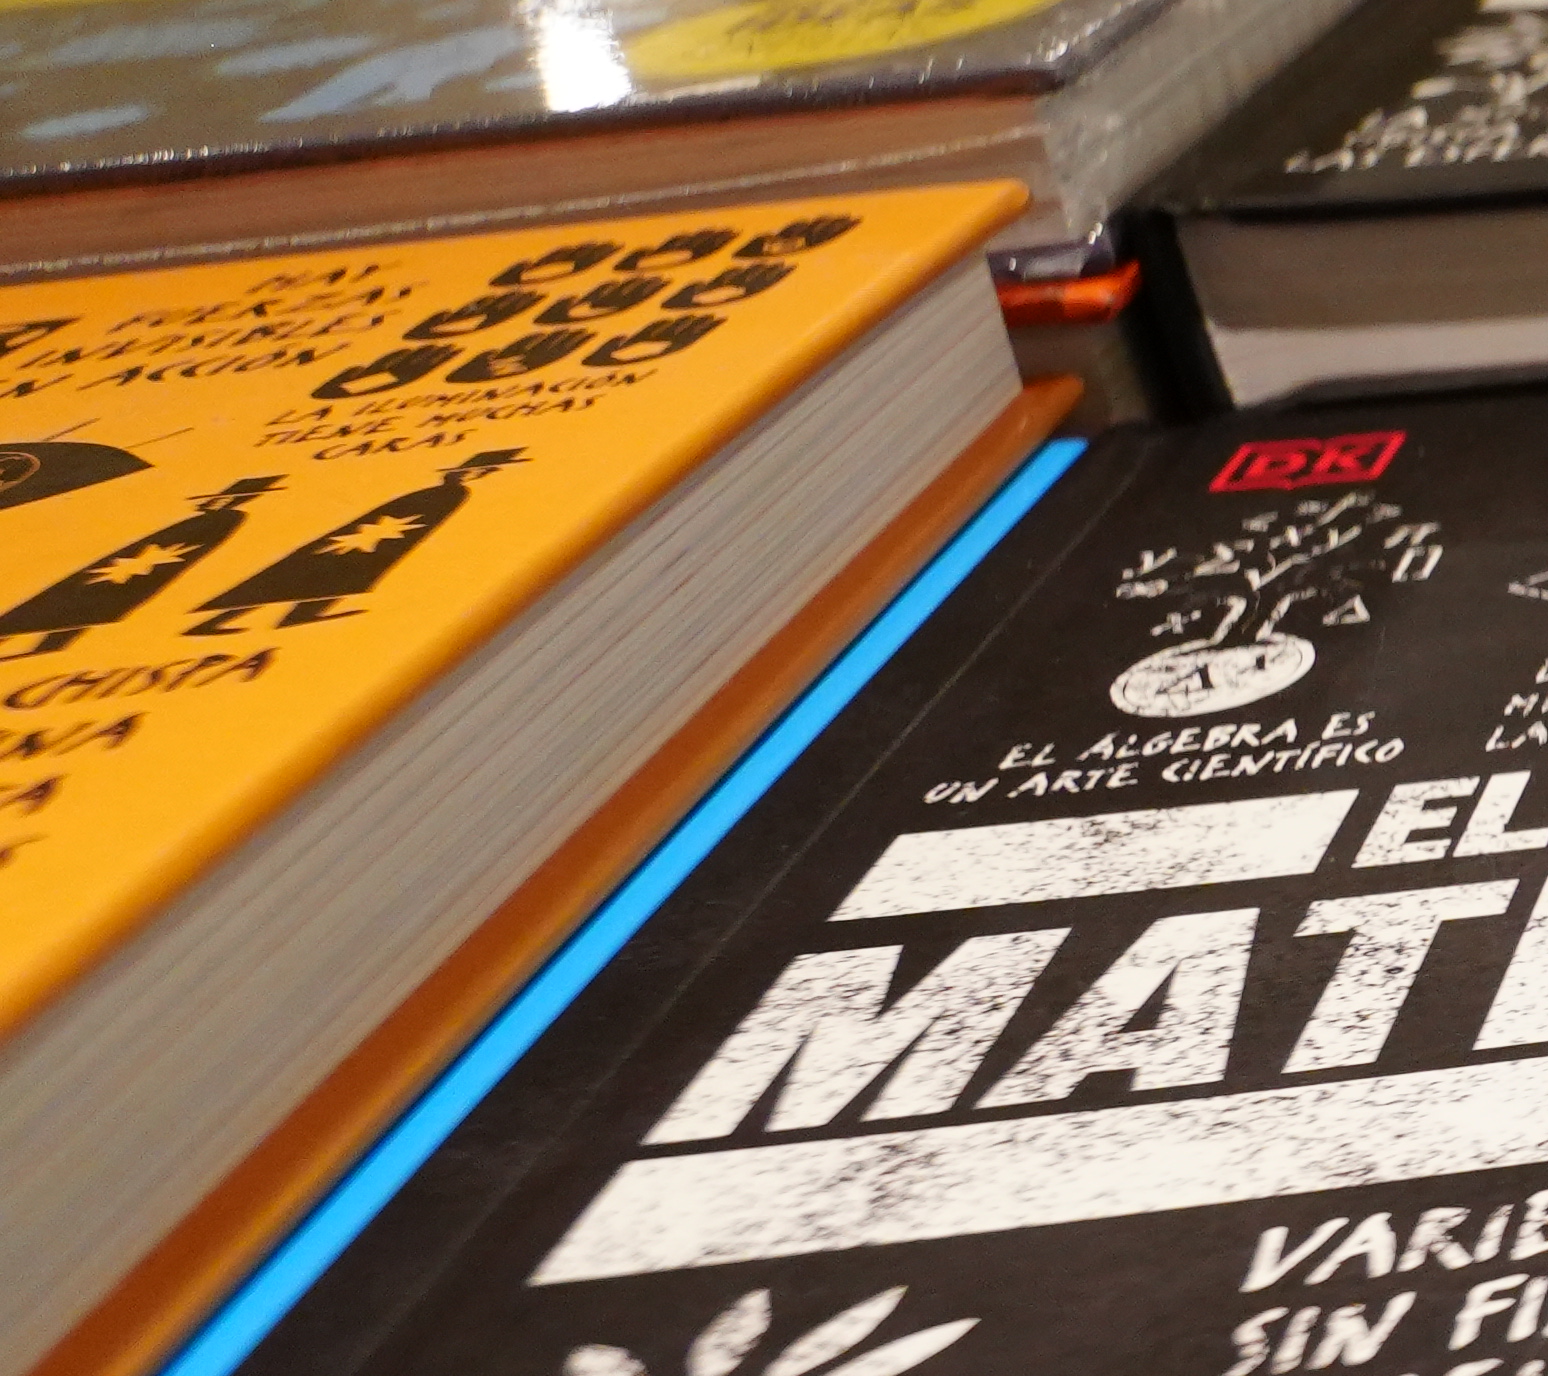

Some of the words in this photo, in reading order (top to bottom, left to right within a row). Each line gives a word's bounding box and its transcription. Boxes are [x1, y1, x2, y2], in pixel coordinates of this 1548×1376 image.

[17, 309, 402, 372] INVISIBLES
[254, 415, 401, 448] TIENE
[421, 392, 611, 428] MUCHAS
[265, 404, 332, 427] LA
[311, 427, 480, 461] CARAS
[1225, 440, 1377, 486] DK
[2, 646, 281, 711] CHISPA
[921, 776, 999, 806] UN
[1006, 760, 1140, 800] ARTE
[1160, 736, 1408, 785] CIENTÍFICO
[998, 740, 1058, 773] EL
[1320, 711, 1379, 740] ES
